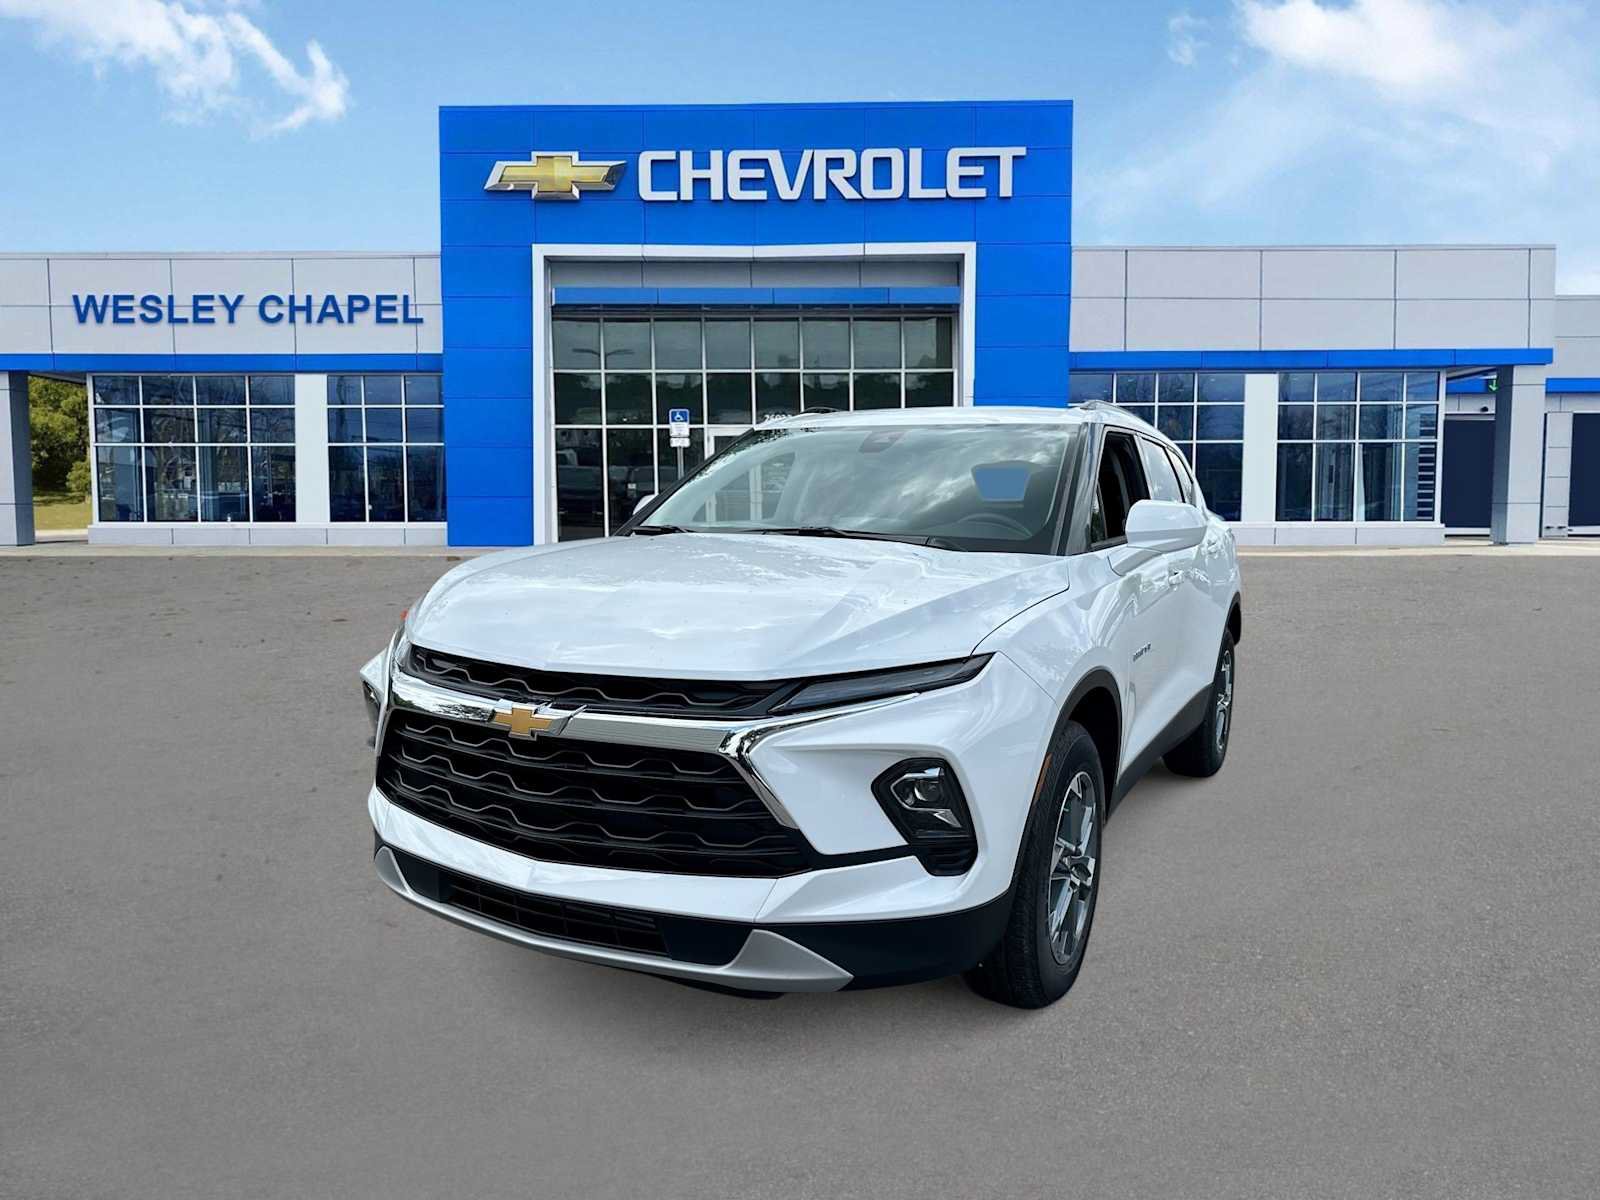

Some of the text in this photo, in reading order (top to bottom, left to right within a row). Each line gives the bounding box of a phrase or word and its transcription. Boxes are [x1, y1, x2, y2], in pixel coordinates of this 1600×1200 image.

[638, 146, 1027, 201] CHEVROLET
[72, 294, 424, 324] WESLEY CHAPEL
